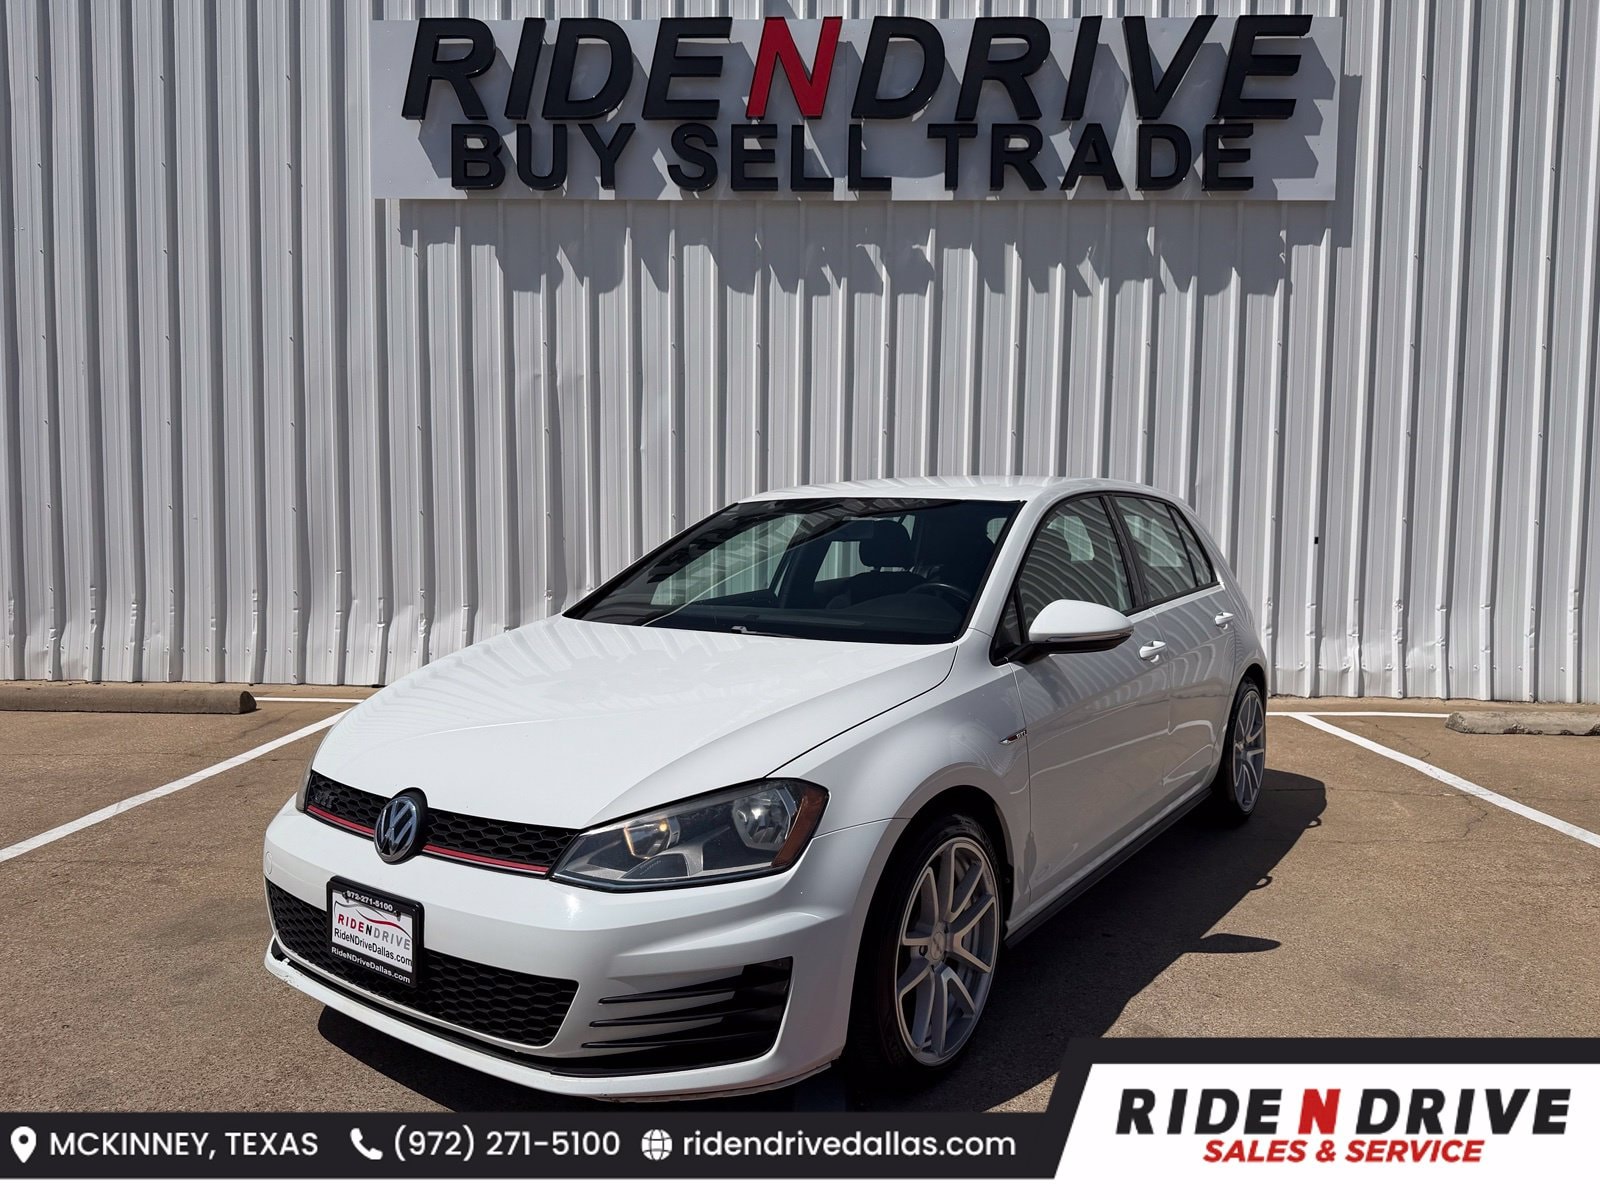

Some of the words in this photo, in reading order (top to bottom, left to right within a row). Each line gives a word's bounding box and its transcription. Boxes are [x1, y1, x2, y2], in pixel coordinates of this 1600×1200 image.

[450, 122, 637, 191] BUY
[667, 122, 892, 191] SELL
[927, 122, 1255, 192] TRADE
[346, 890, 393, 912] 972-271-5100
[331, 946, 411, 984] RideNDriveDallas.com
[334, 927, 412, 967] RideNDriveDallas.com
